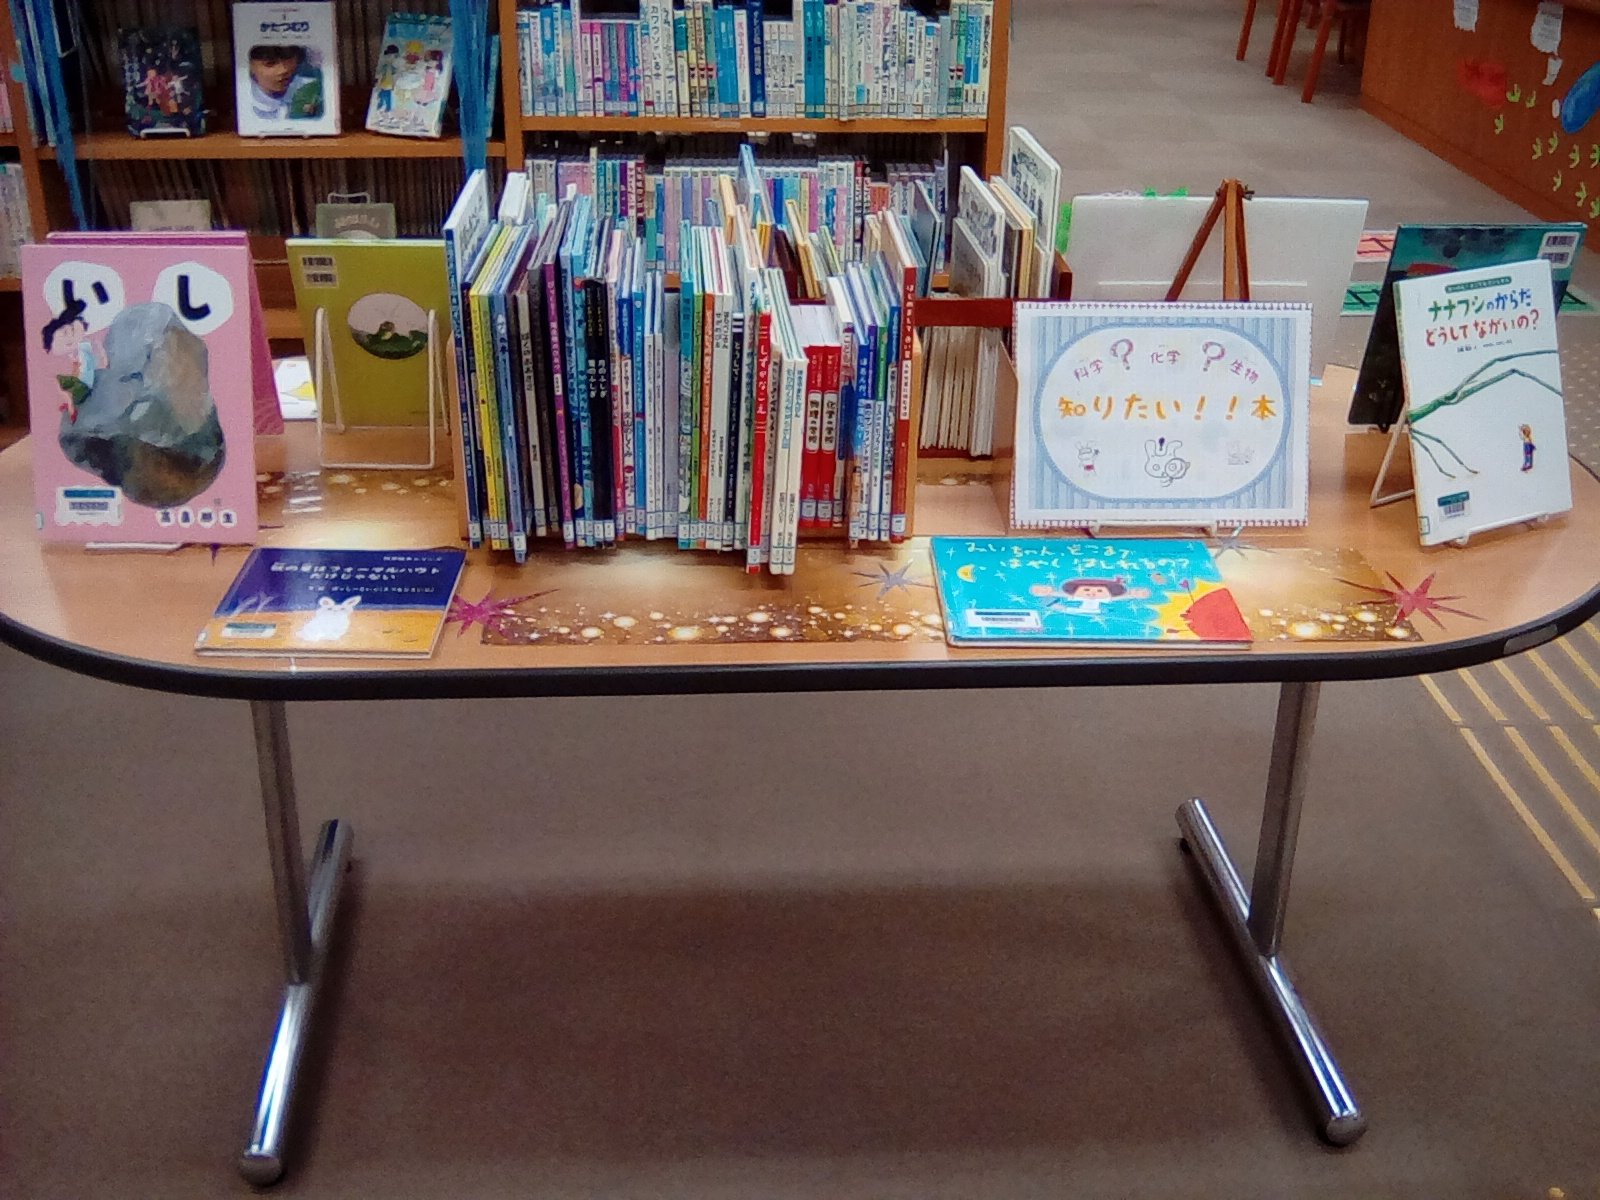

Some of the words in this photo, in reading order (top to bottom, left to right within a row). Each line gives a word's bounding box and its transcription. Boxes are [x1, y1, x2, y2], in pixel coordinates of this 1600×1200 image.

[260, 21, 310, 32] かたつむり
[1428, 288, 1532, 322] ナナフシのからだ
[1073, 360, 1105, 382] 科学
[1150, 350, 1182, 365] 化学
[1229, 359, 1260, 384] 生物
